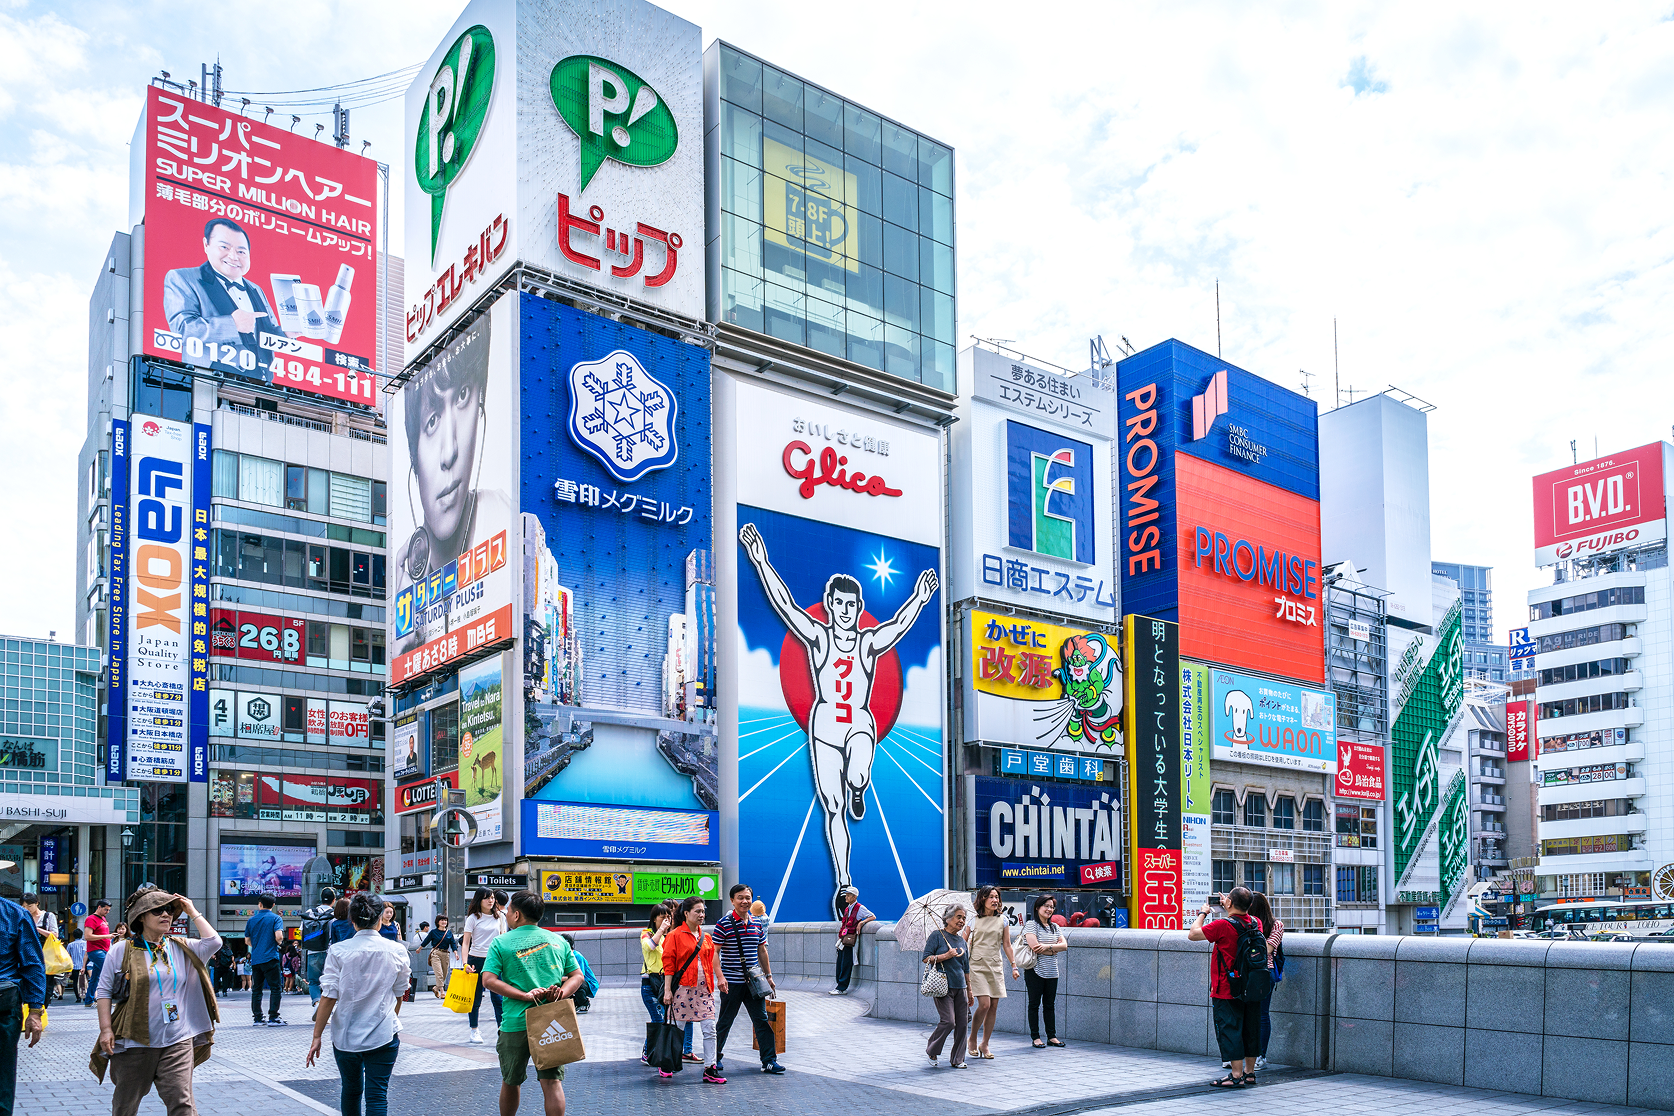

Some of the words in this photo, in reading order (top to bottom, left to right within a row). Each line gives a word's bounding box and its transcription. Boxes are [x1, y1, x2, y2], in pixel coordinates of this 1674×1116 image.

[157, 95, 281, 150] スーパー
[157, 125, 372, 208] ミリオンヘアー
[156, 157, 232, 194] SUPER
[238, 182, 316, 220] MILLION
[321, 208, 372, 237] HAIR
[557, 192, 684, 288] ピップ
[406, 212, 510, 343] ピップエレキバン
[263, 336, 302, 353] ルアン
[185, 336, 372, 399] 0120-494-111
[1010, 363, 1081, 399] 夢ある住まい
[999, 384, 1094, 428] エステムシリーズ
[792, 416, 890, 456] おいしさと健康
[1228, 423, 1249, 439] SMBC
[1228, 434, 1268, 457] CONSUMER
[1229, 444, 1261, 464] FINANCE
[782, 440, 903, 499] Glico
[1125, 382, 1161, 577] PROMISE
[1574, 465, 1595, 476] Since
[554, 477, 693, 525] 雪印メグミルク
[1567, 473, 1631, 525] B.V.D.
[111, 504, 124, 548] Leading
[1576, 528, 1640, 553] FUJIBO
[113, 553, 123, 572] Tax
[1195, 525, 1318, 600] PROMISE
[112, 576, 123, 602] Free
[397, 535, 504, 632] サタデープラス
[982, 553, 1115, 608] 日商エステム
[112, 606, 123, 635] Store
[414, 597, 455, 631] SATURDAY
[455, 586, 475, 610] PLUS
[1274, 596, 1318, 627] プロミス
[292, 619, 305, 627] 5F
[984, 618, 1047, 649] かぜに
[1577, 630, 1599, 639] RIDE
[112, 640, 122, 651] in
[138, 634, 180, 648] Japan
[239, 622, 301, 652] 268
[138, 646, 180, 661] Quality
[138, 658, 180, 671] Store
[403, 634, 458, 678] 土曜あさ8時
[110, 655, 122, 688] Japan
[978, 645, 1054, 689] 改源
[131, 691, 154, 699] ここから
[154, 692, 183, 701] 徒歩7分
[461, 696, 480, 713] Travel
[485, 691, 501, 705] Nara
[832, 655, 855, 725] グリコ
[131, 717, 153, 725] ここから
[154, 718, 182, 727] 徒歩1分
[308, 708, 369, 724] 女性のお客様
[308, 718, 345, 730] 飲み放題
[467, 710, 496, 728] Kintetsu.
[344, 722, 369, 738] 0円
[1182, 668, 1195, 810] 株式会社日本リート
[1258, 723, 1322, 755] WAON
[1515, 711, 1528, 752] カラオケ
[3, 739, 35, 751] なんば
[130, 741, 153, 750] ここから
[153, 743, 182, 752] 徒歩11分
[130, 767, 153, 775] ここから
[153, 768, 182, 777] 徒歩1分
[1006, 752, 1099, 777] 戸堂歯科
[990, 784, 1120, 861] CHINTAI
[1183, 816, 1206, 825] NIHON
[602, 845, 647, 855] 雪印メグミルク
[1144, 853, 1177, 869] スーパー
[404, 878, 416, 886] Toilets
[489, 876, 517, 885] Toilets
[1095, 866, 1112, 879] 検索
[661, 876, 696, 895] ピタットハウス
[538, 1031, 574, 1046] adidas
